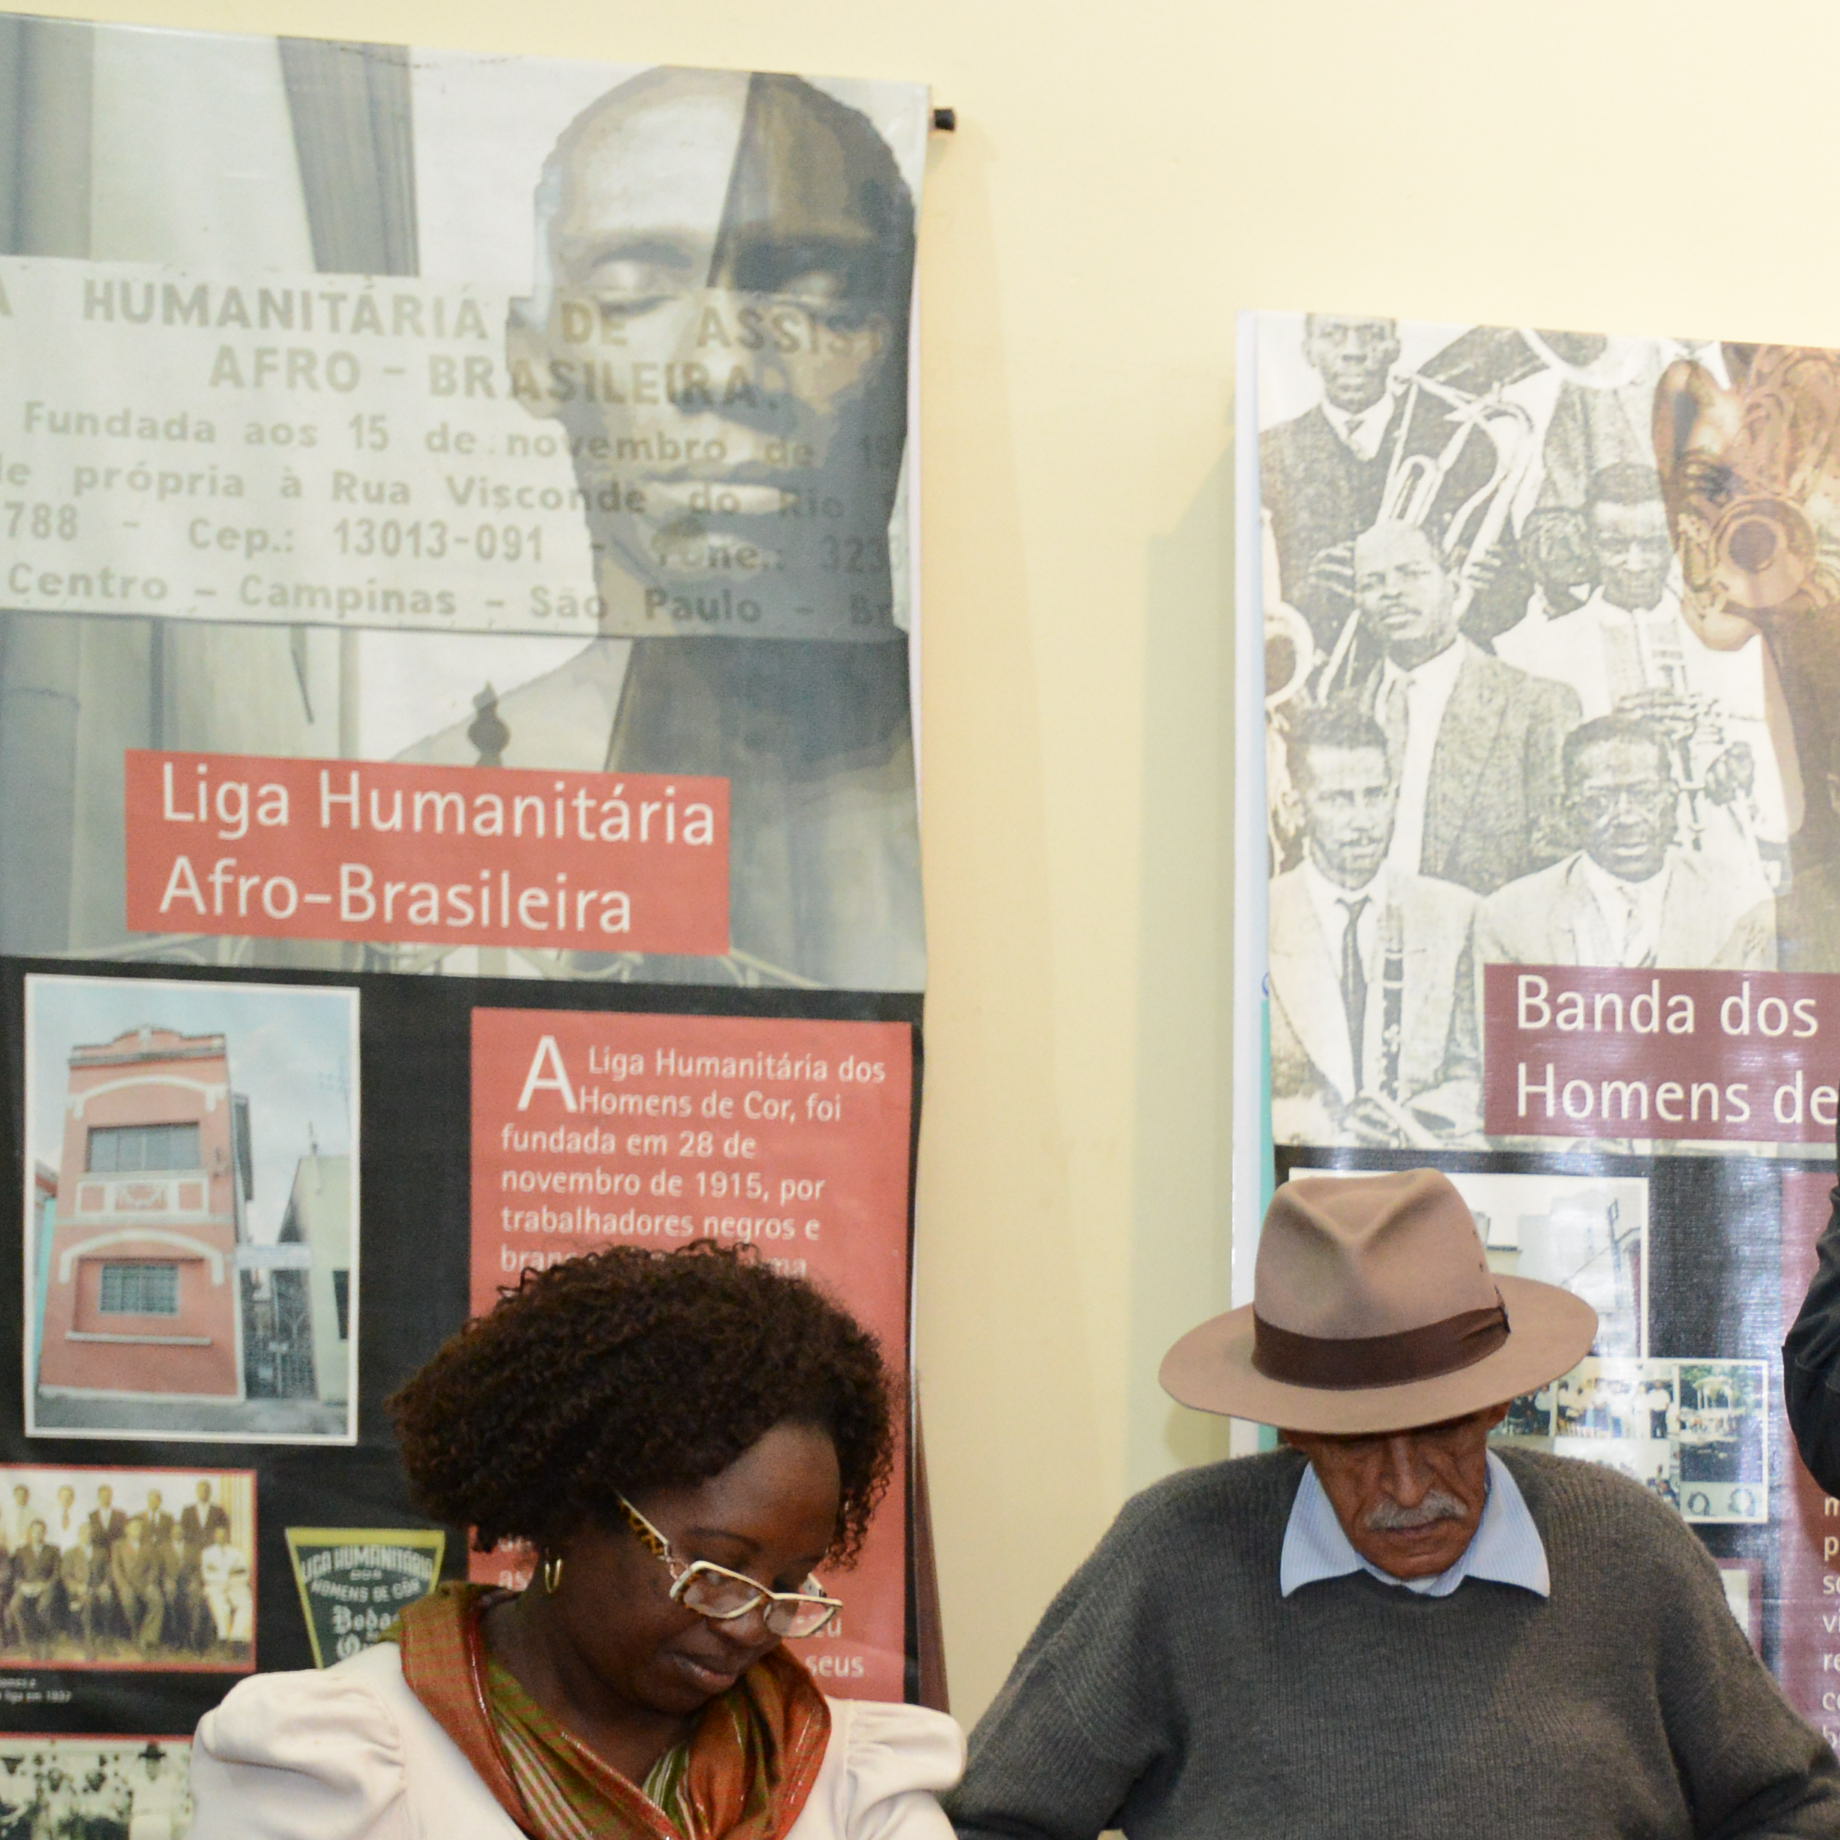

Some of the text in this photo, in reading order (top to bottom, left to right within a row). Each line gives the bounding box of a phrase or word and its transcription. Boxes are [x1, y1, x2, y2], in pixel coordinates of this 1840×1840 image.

[561, 301, 628, 347] DE
[209, 344, 361, 394] AFRO
[24, 401, 815, 467] Fundada aos 15 de novembro de
[72, 461, 244, 498] própria
[279, 467, 303, 498] à
[331, 470, 410, 505] Rua
[445, 475, 646, 513] Visconde
[689, 482, 741, 514] do
[6, 502, 78, 540] 788
[188, 518, 294, 559] Cep.:
[334, 517, 543, 562] 13013-091
[8, 563, 762, 622] Centro Campinas São Paulo
[161, 762, 716, 846] Liga Humanitária
[160, 855, 632, 935] Afro-Brasileira
[1517, 974, 1818, 1039] Banda dos
[517, 1035, 885, 1112] A Liga Humanitária dos
[1517, 1062, 1839, 1125] Homens de
[578, 1085, 841, 1124] Homens de Cor, foi
[502, 1123, 756, 1160] fundada em 28 de
[502, 1167, 826, 1205] novembro de 1915, por
[502, 1207, 820, 1243] trabalhadores negros e
[310, 1580, 369, 1602] HOMENS
[372, 1585, 390, 1602] DE
